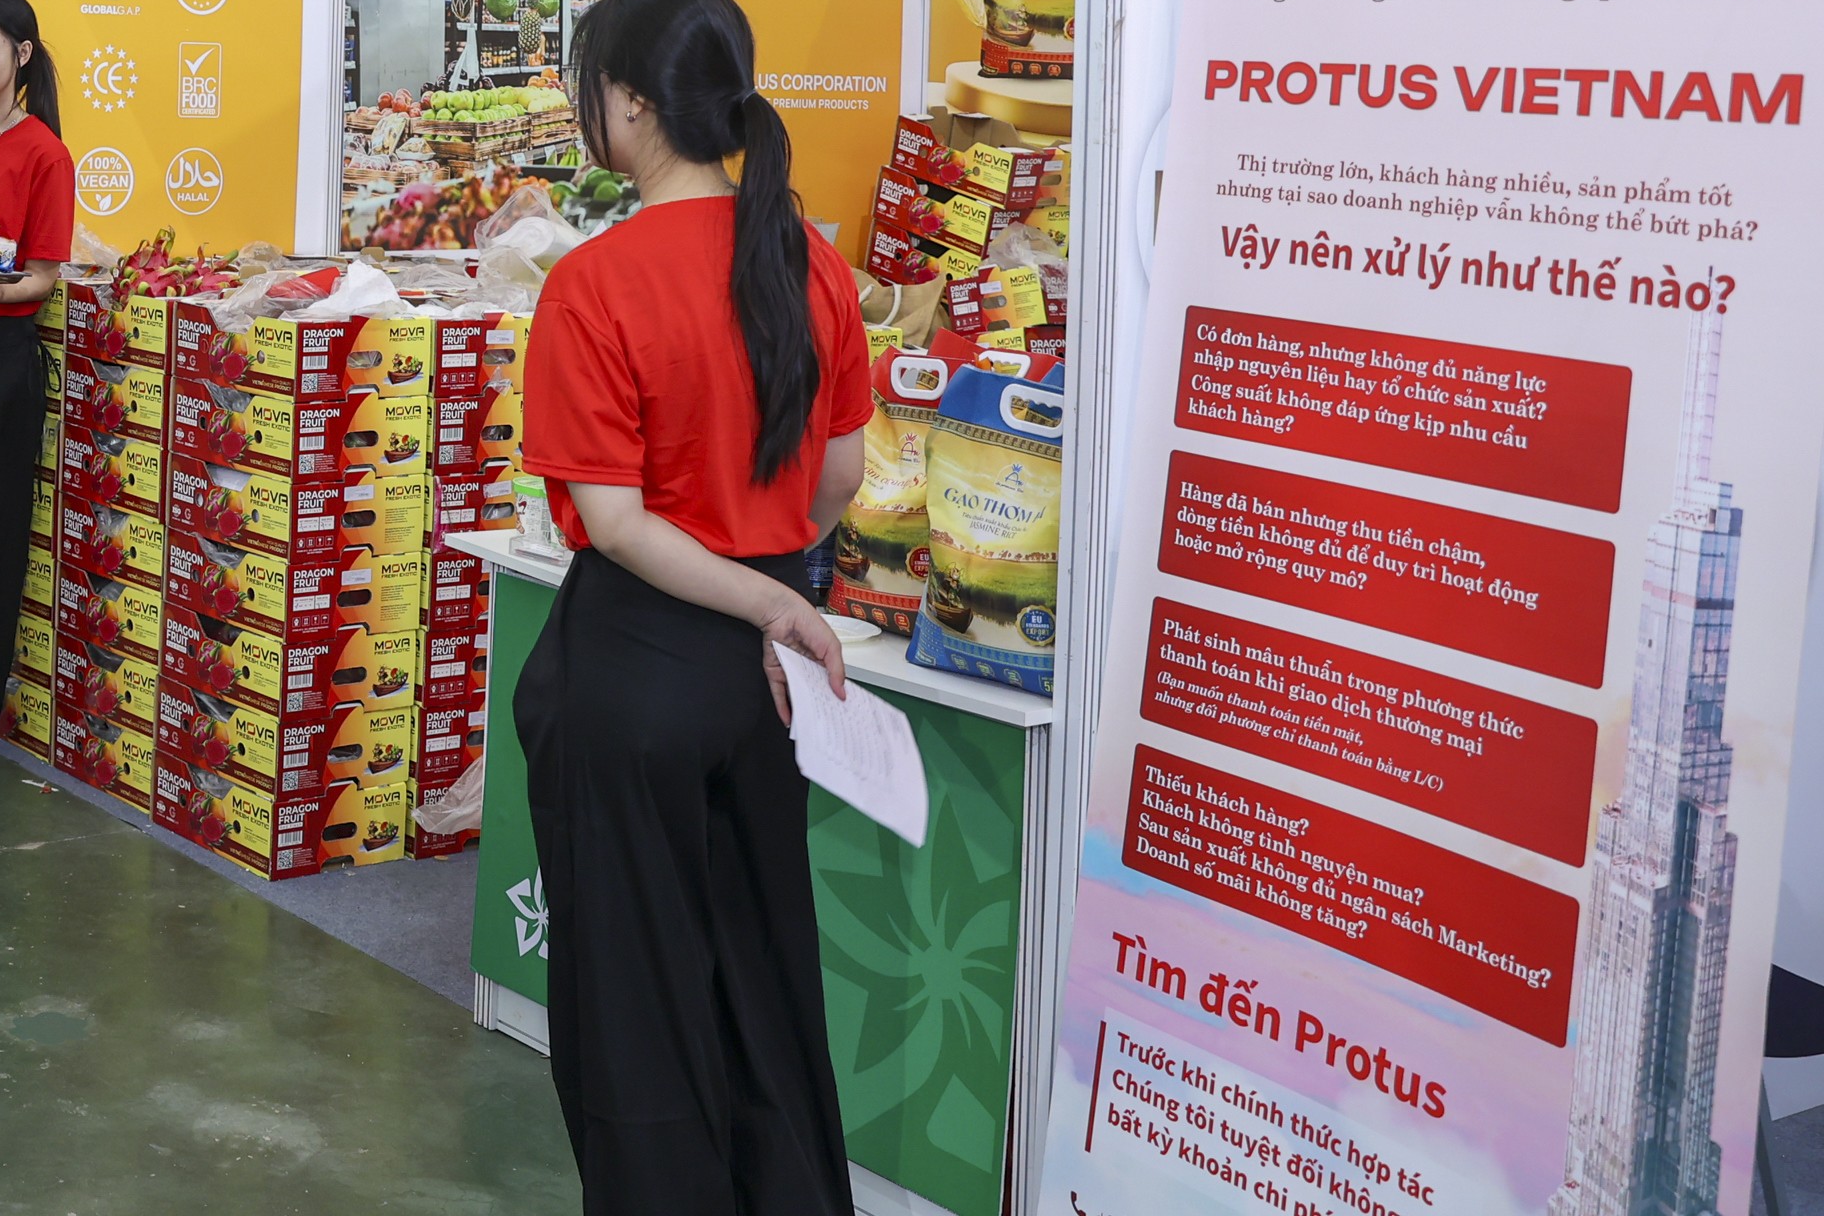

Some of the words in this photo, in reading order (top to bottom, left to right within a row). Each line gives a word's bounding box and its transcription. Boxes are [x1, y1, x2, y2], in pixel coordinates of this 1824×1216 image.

[94, 62, 122, 94] CE
[182, 77, 216, 94] BRC
[755, 74, 778, 90] US
[781, 74, 886, 92] CORPORATION
[182, 94, 216, 108] FOOD
[1205, 60, 1438, 110] PROTUS
[1454, 65, 1804, 125] VIETNAM
[773, 98, 816, 108] PREMIUM
[819, 99, 869, 110] PRODUCTS
[898, 137, 921, 150] FRUIT
[899, 129, 933, 147] DRAGON
[87, 157, 122, 170] 100%
[974, 149, 1010, 169] MOVA
[80, 174, 128, 188] VEGAN
[1237, 153, 1267, 176] Thị
[1272, 156, 1334, 181] trường
[1338, 160, 1375, 183] lớn,
[1379, 163, 1440, 186] khách
[1445, 166, 1498, 194] hàng
[1504, 170, 1571, 198] nhiều,
[1578, 175, 1616, 198] sản
[1623, 176, 1691, 208] phẩm
[1698, 180, 1733, 208] tốt
[177, 192, 209, 202] HALAL
[1221, 224, 1280, 271] Vậy
[1289, 230, 1353, 272] nên
[1362, 236, 1411, 277] xử
[1417, 242, 1451, 290] lý
[1460, 250, 1541, 292] như
[1548, 256, 1622, 302] thế
[1628, 264, 1736, 315] nào?
[68, 299, 96, 314] DRAGON
[131, 305, 163, 322] MOVA
[68, 310, 87, 322] FRUIT
[178, 318, 211, 335] DRAGON
[255, 326, 293, 344] MOVA
[303, 328, 344, 338] DRAGON
[389, 327, 424, 337] MOVA
[178, 329, 200, 342] FRUIT
[303, 338, 330, 347] FRUIT
[255, 339, 271, 347] FRESH
[273, 343, 293, 351] EXOTIC
[1197, 324, 1217, 343] Có
[1221, 327, 1252, 349] đơn
[1257, 332, 1305, 359] hàng,
[1308, 343, 1366, 368] nhưng
[1370, 349, 1428, 378] không
[1432, 358, 1457, 379] đủ
[1462, 365, 1511, 393] năng
[1515, 370, 1547, 396] lực
[944, 488, 979, 509] GẠO
[984, 498, 1032, 523] THƠM
[1031, 615, 1042, 623] EU
[1145, 764, 1192, 797] Thiếu
[1196, 783, 1250, 818] khách
[1255, 802, 1310, 837] hàng?
[1112, 931, 1187, 1001] Tìm
[1199, 972, 1281, 1042] đến
[1295, 1009, 1448, 1119] Protus
